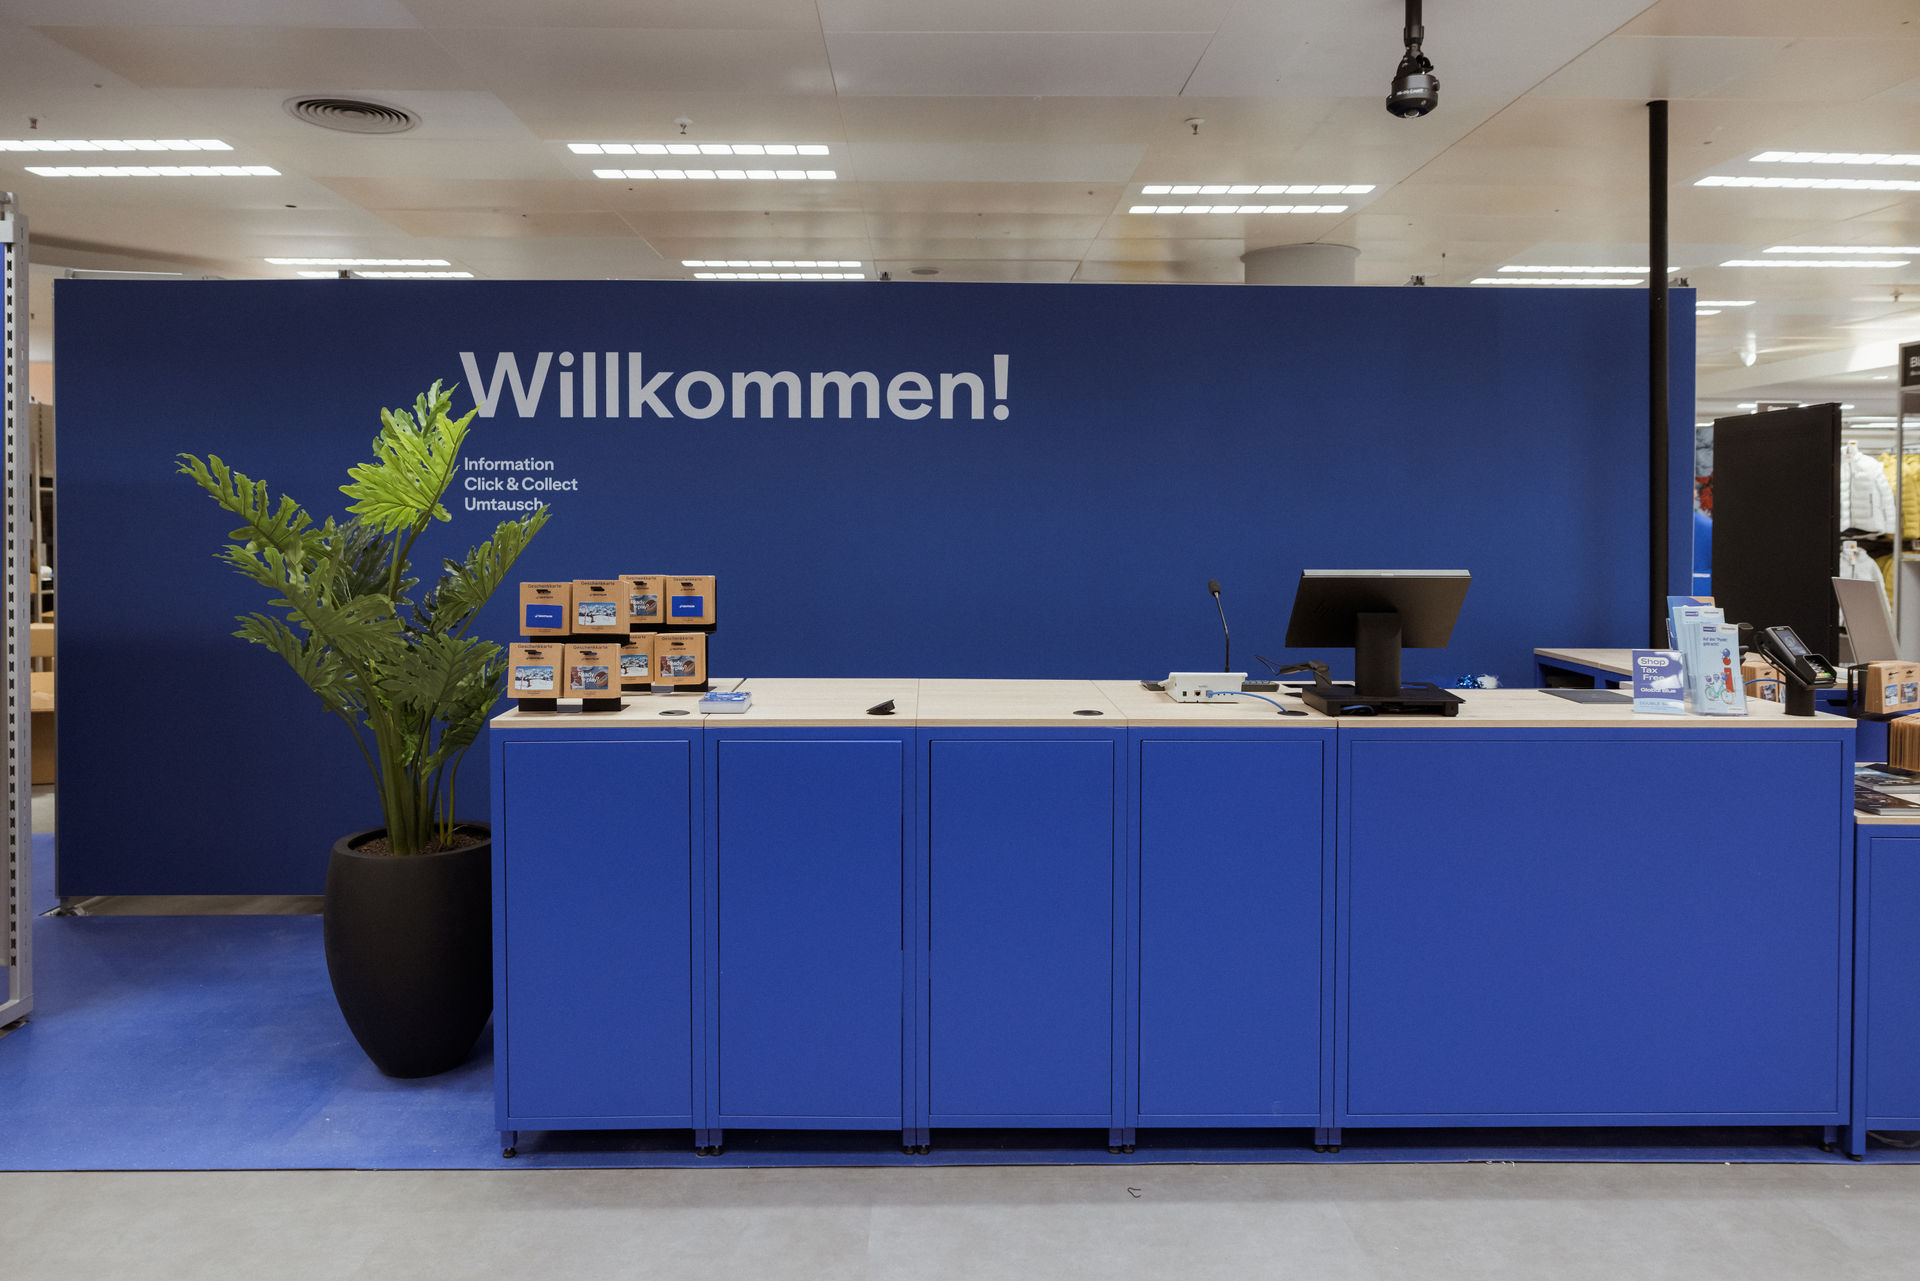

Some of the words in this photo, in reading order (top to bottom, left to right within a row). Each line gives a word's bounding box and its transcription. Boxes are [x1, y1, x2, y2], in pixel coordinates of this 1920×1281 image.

[459, 351, 1010, 421] Willkommen!
[464, 457, 554, 471] Information
[464, 477, 504, 491] Click
[506, 477, 519, 491] &
[522, 477, 578, 491] Collect
[464, 497, 543, 511] Umtausch
[1640, 658, 1666, 666] Shop
